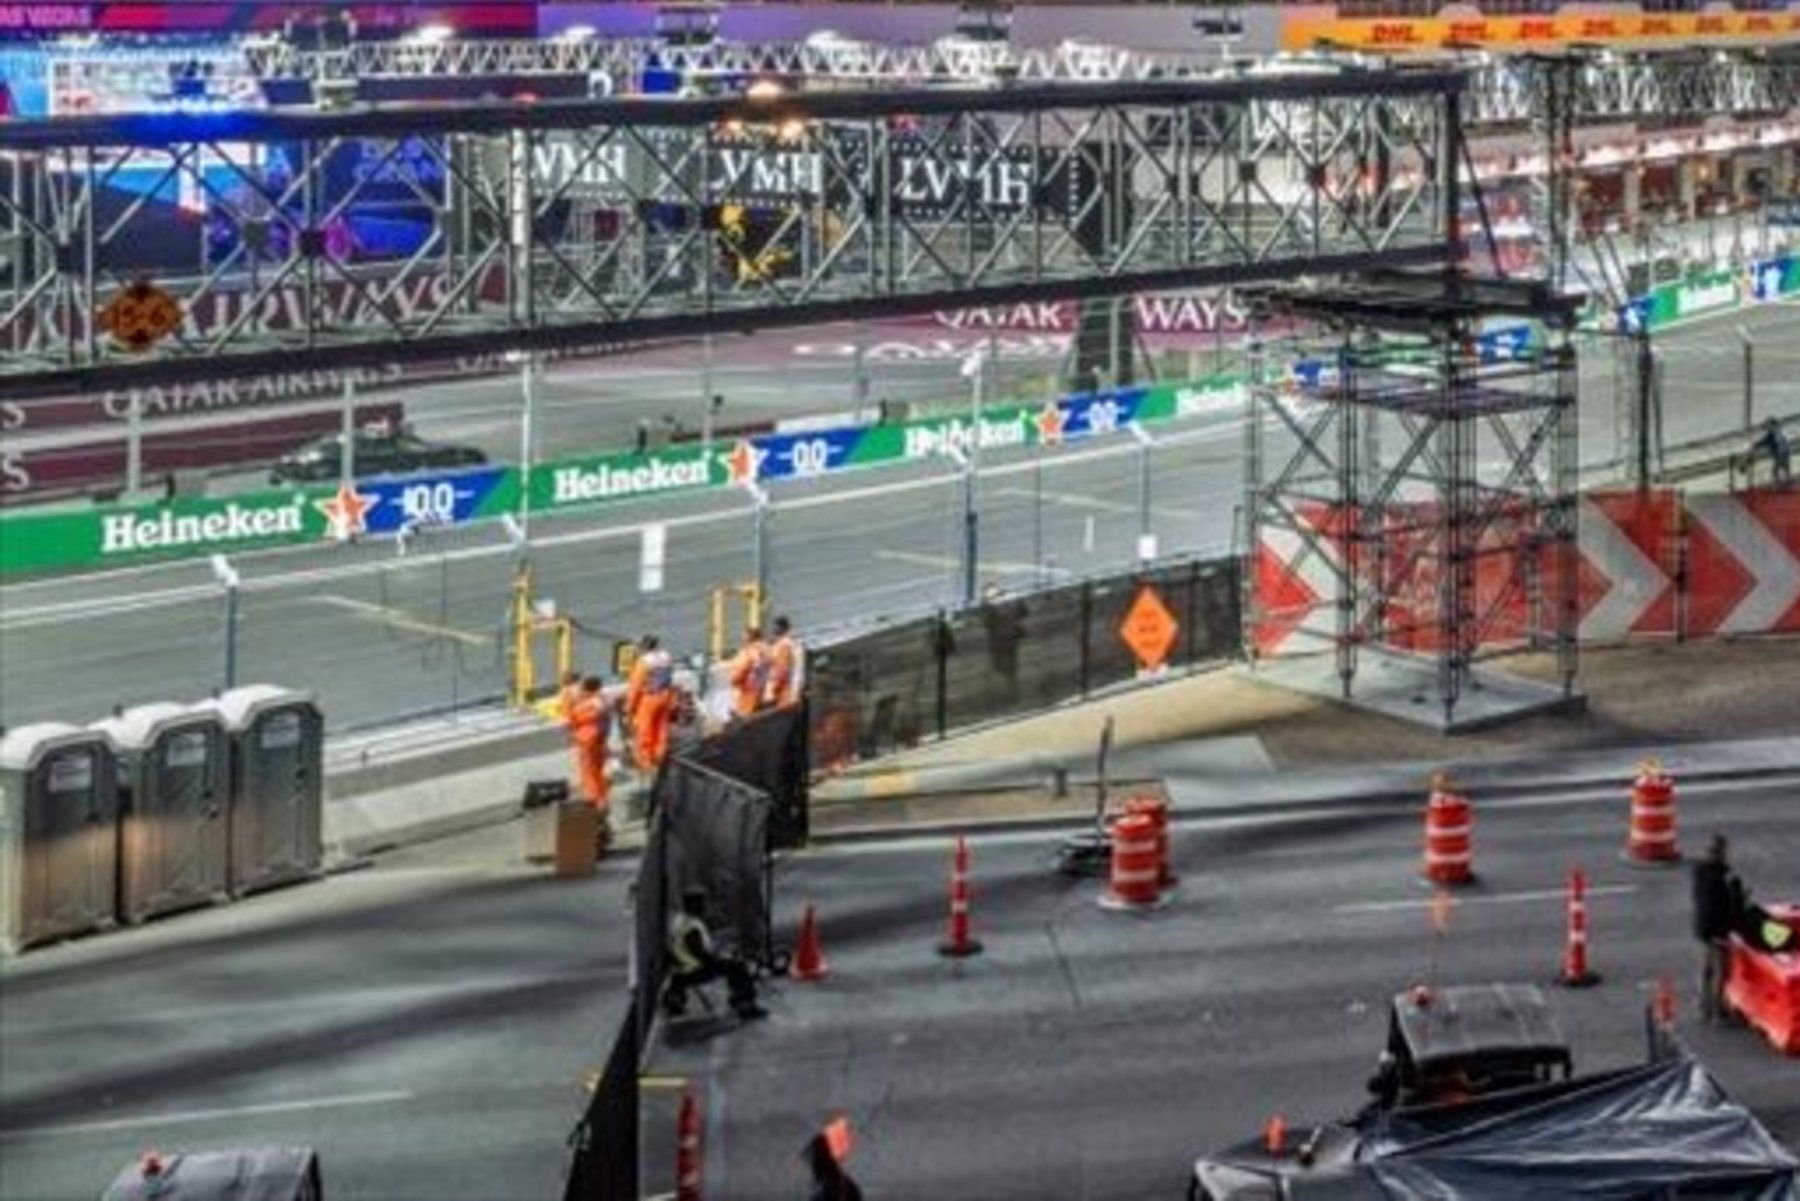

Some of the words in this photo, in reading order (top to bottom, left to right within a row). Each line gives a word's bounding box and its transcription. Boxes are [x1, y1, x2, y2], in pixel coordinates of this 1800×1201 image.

[27, 4, 92, 28] VEGAS
[1369, 22, 1418, 43] DHL
[553, 459, 710, 502] Heineken
[102, 500, 304, 553] Heineken
